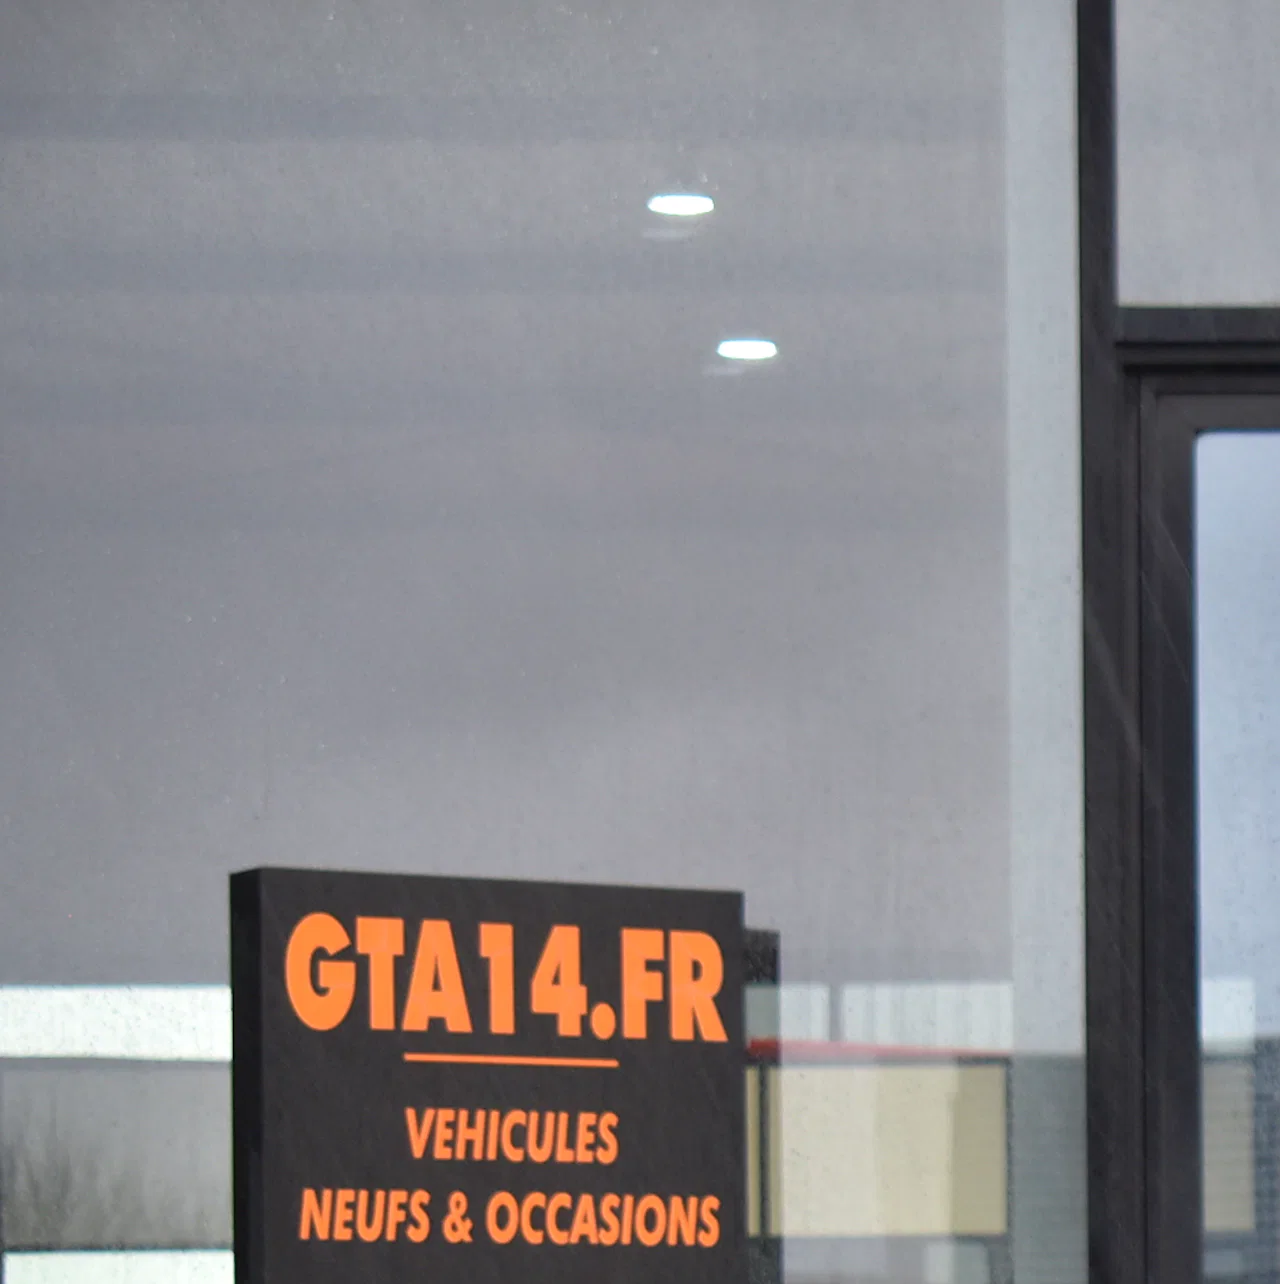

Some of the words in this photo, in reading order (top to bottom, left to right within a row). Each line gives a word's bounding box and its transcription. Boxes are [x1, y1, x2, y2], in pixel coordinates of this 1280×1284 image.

[283, 911, 729, 1043] GTA14.FR
[403, 1106, 620, 1166] VEHICULES
[298, 1187, 431, 1244] NEUFS
[441, 1189, 474, 1244] &
[484, 1189, 722, 1249] OCCASIONS
